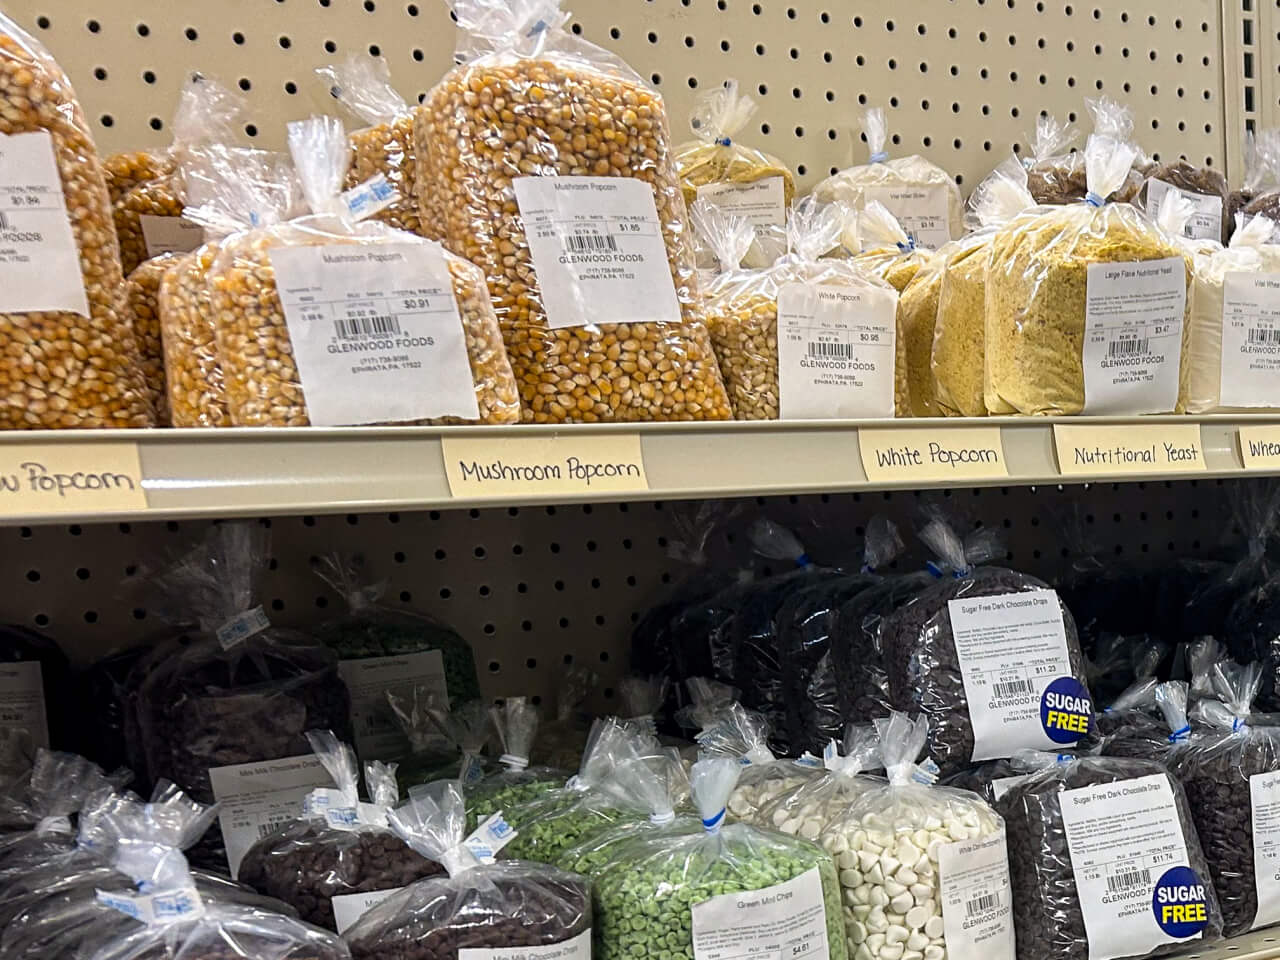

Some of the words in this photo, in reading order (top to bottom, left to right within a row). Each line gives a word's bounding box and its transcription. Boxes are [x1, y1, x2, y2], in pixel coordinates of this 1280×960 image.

[559, 255, 613, 264] GLENWOOD
[818, 292, 835, 300] White
[836, 294, 861, 302] Popcorn
[328, 342, 394, 354] GLENWOOD
[396, 337, 434, 347] FOODS
[800, 360, 847, 369] GLENWOOD
[848, 362, 876, 371] FOODS
[1101, 359, 1141, 369] GLENWOOD
[876, 447, 922, 468] White
[929, 443, 998, 468] Popcorn
[1074, 444, 1156, 465] Nutritional
[1164, 443, 1198, 462] Yeast
[27, 461, 135, 494] Popcorn
[460, 459, 561, 483] Mushroom
[567, 458, 641, 483] Popcorn
[962, 604, 978, 614] Sugar
[978, 604, 991, 612] Free
[992, 602, 1006, 611] Dark
[989, 698, 1030, 709] GLENWOOD
[1045, 692, 1091, 714] SUGAR
[1046, 710, 1089, 733] FREE
[1073, 795, 1092, 805] Sugar
[1092, 793, 1107, 801] Free
[1107, 790, 1122, 799] Dark
[1102, 889, 1146, 904] GLENWOOD
[1157, 885, 1206, 903] SUGAR
[737, 899, 761, 910] Green
[1162, 904, 1207, 924] FREE
